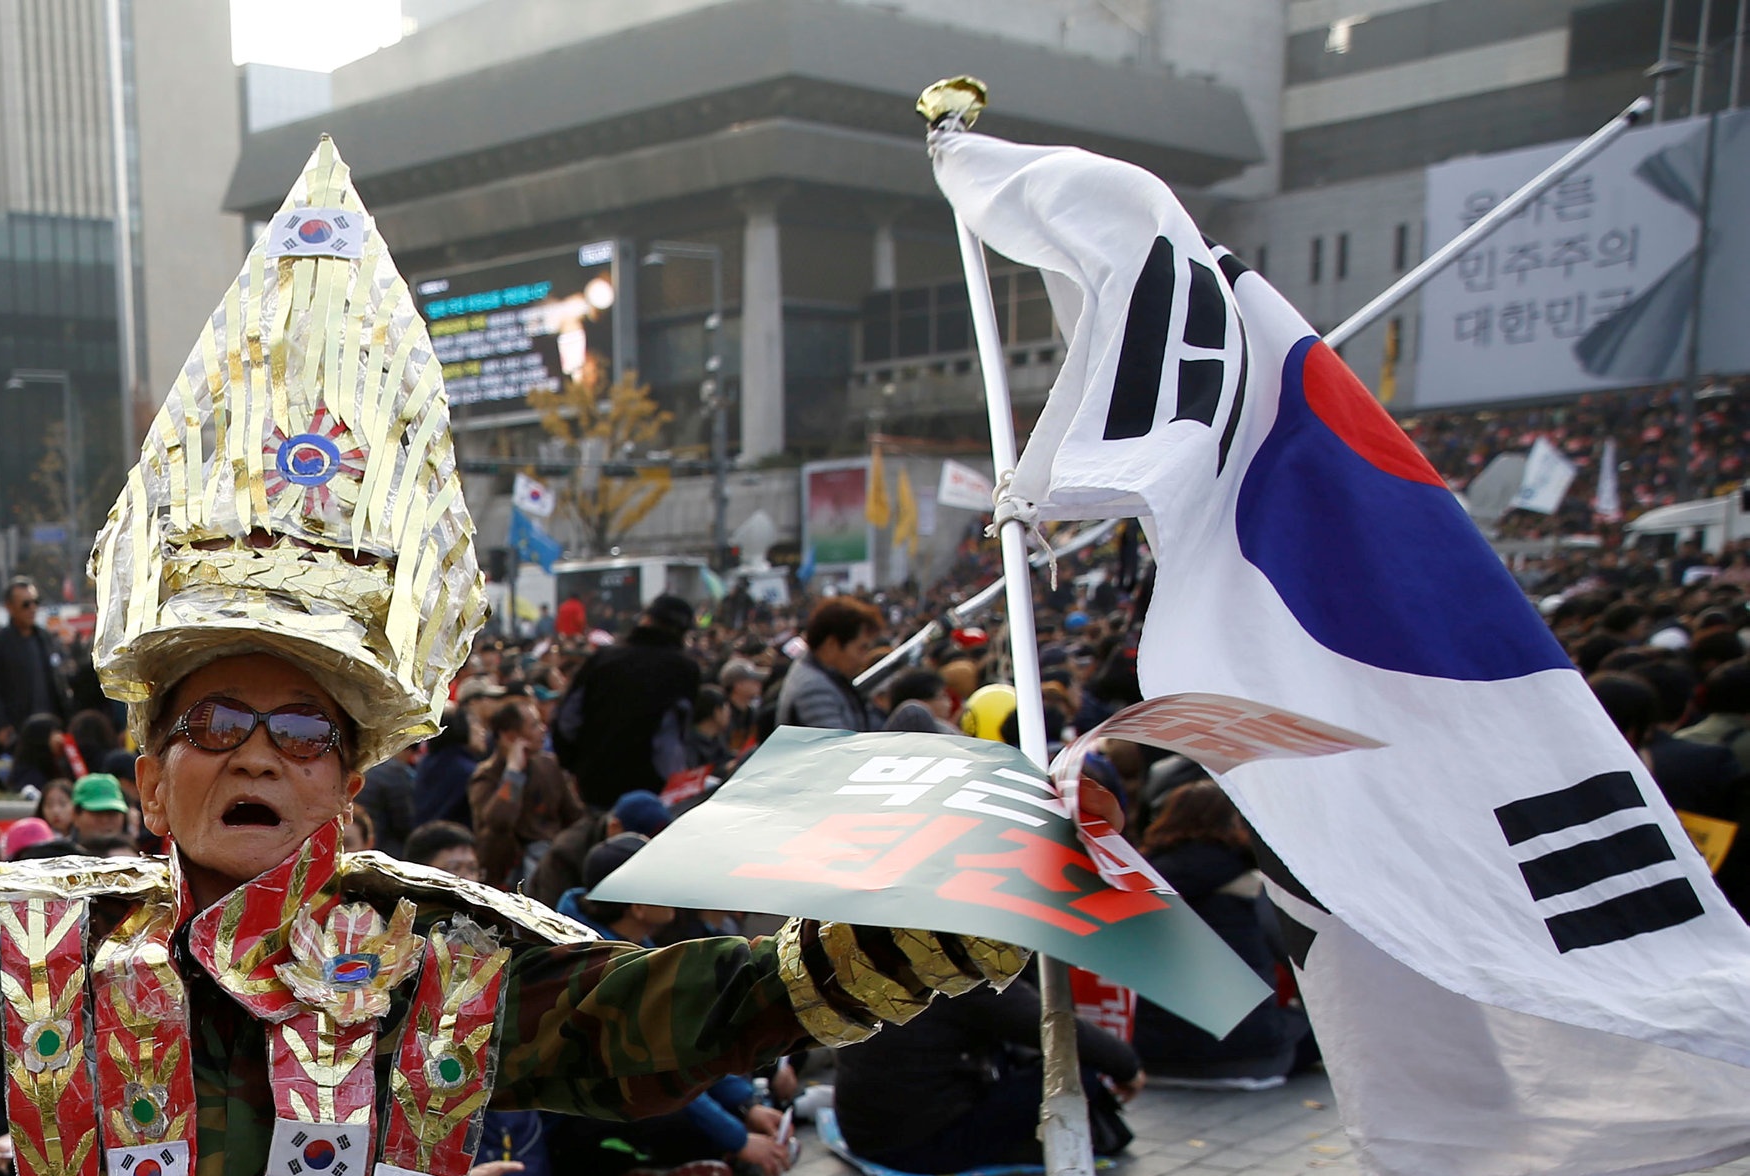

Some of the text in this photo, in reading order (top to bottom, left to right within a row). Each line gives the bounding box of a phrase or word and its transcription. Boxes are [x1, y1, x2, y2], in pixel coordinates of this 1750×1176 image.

[1459, 174, 1595, 230] 올른
[1457, 224, 1639, 293] 민주주의
[834, 756, 1071, 827] 박근
